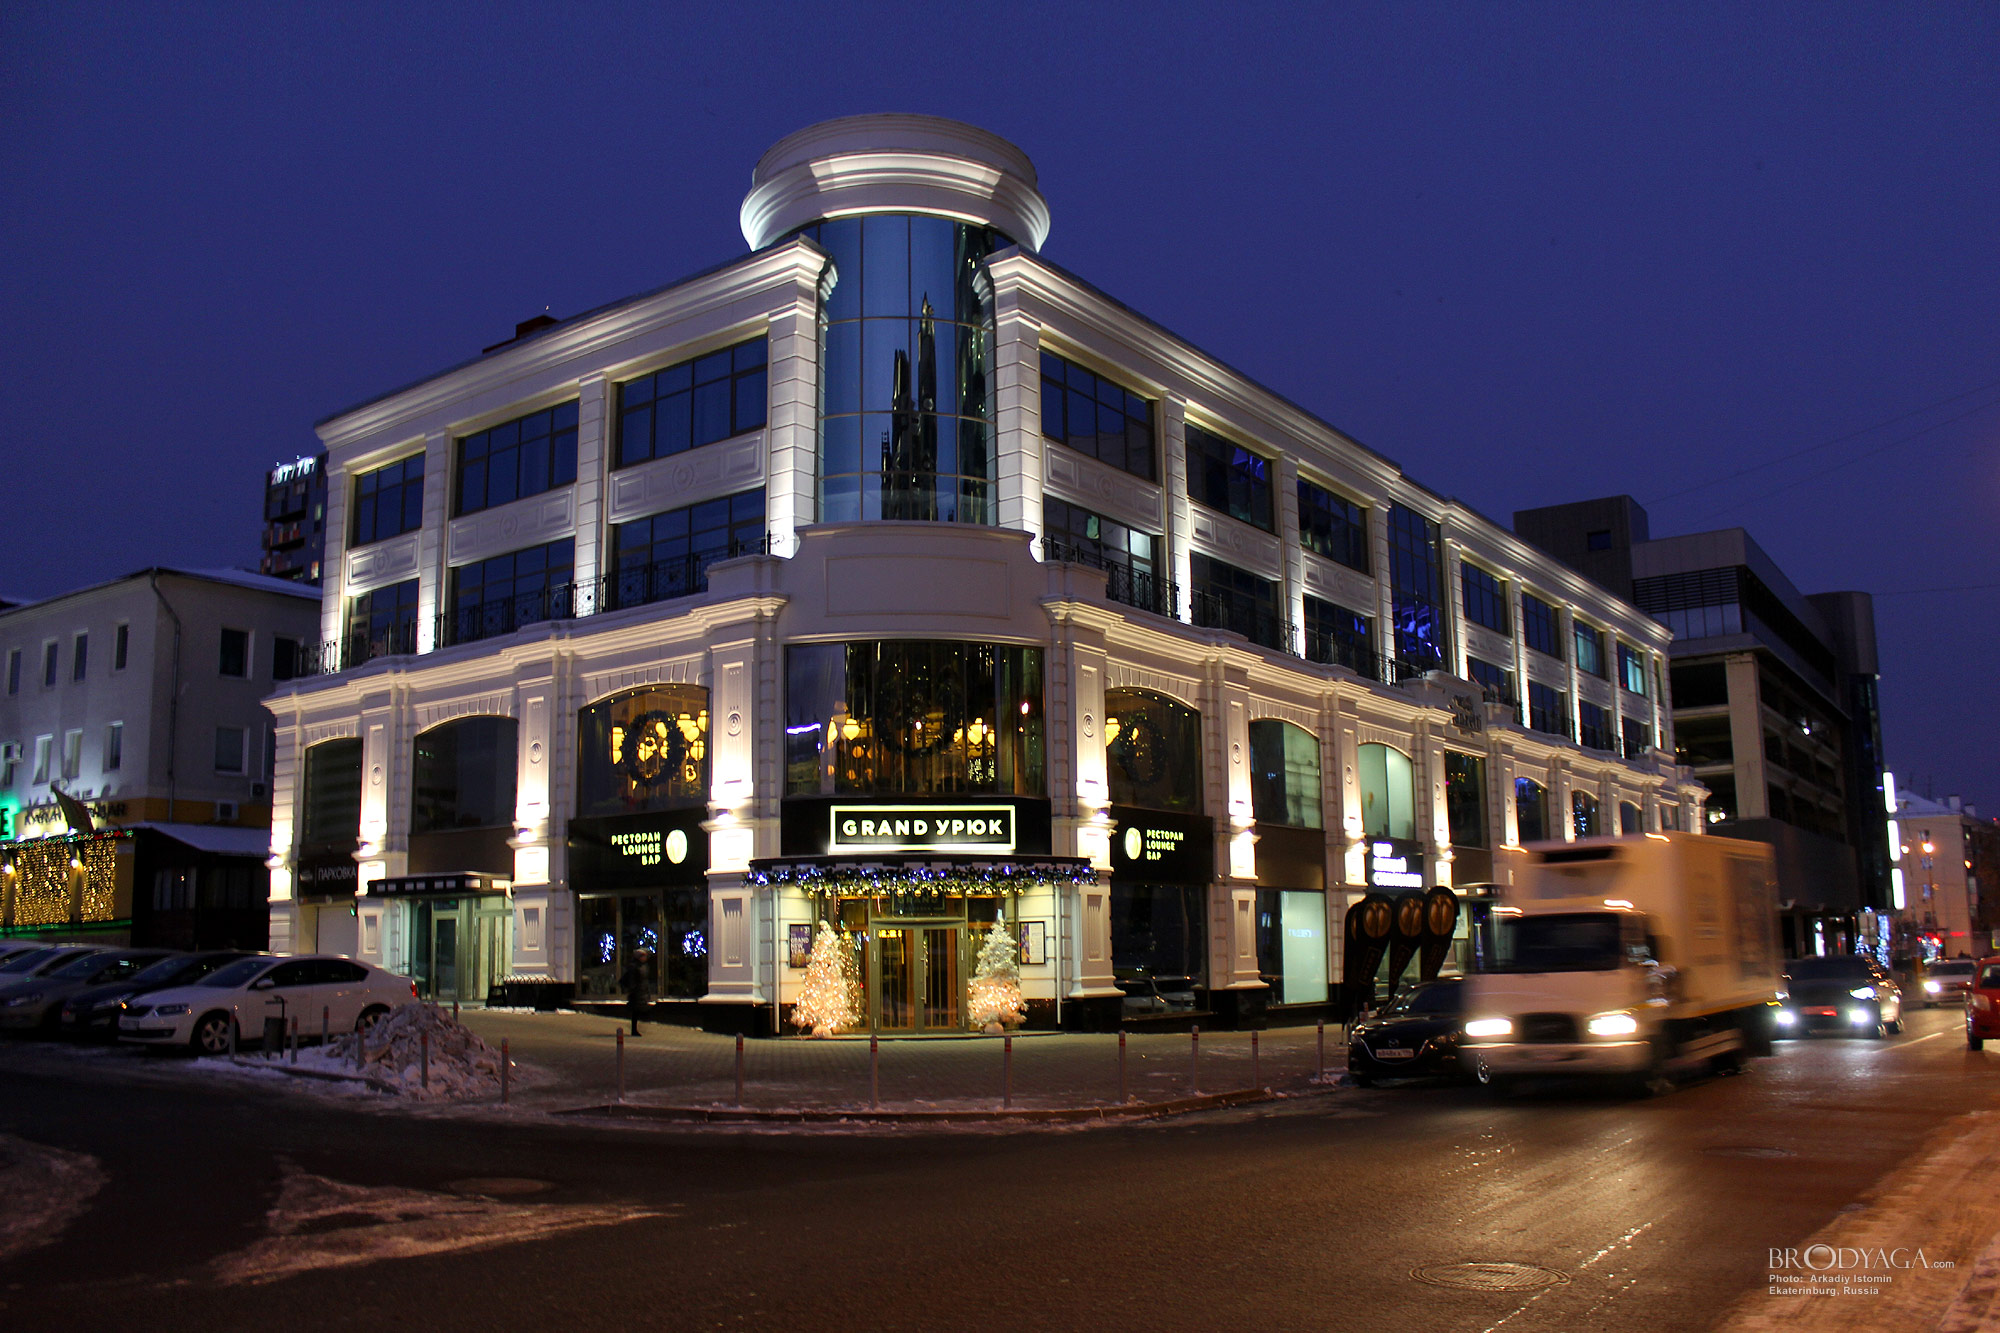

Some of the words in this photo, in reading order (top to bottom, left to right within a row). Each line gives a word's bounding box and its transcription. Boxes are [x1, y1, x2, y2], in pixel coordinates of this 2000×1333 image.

[842, 819, 928, 836] GRAND
[935, 819, 1003, 836] УРЮК
[611, 832, 661, 845] РЕСТОРАН
[1146, 829, 1183, 841] РЕСТОРАН
[622, 843, 661, 855] LOUNGE
[1146, 840, 1175, 850] LOUNGE
[318, 866, 356, 880] ПАРКОВКА
